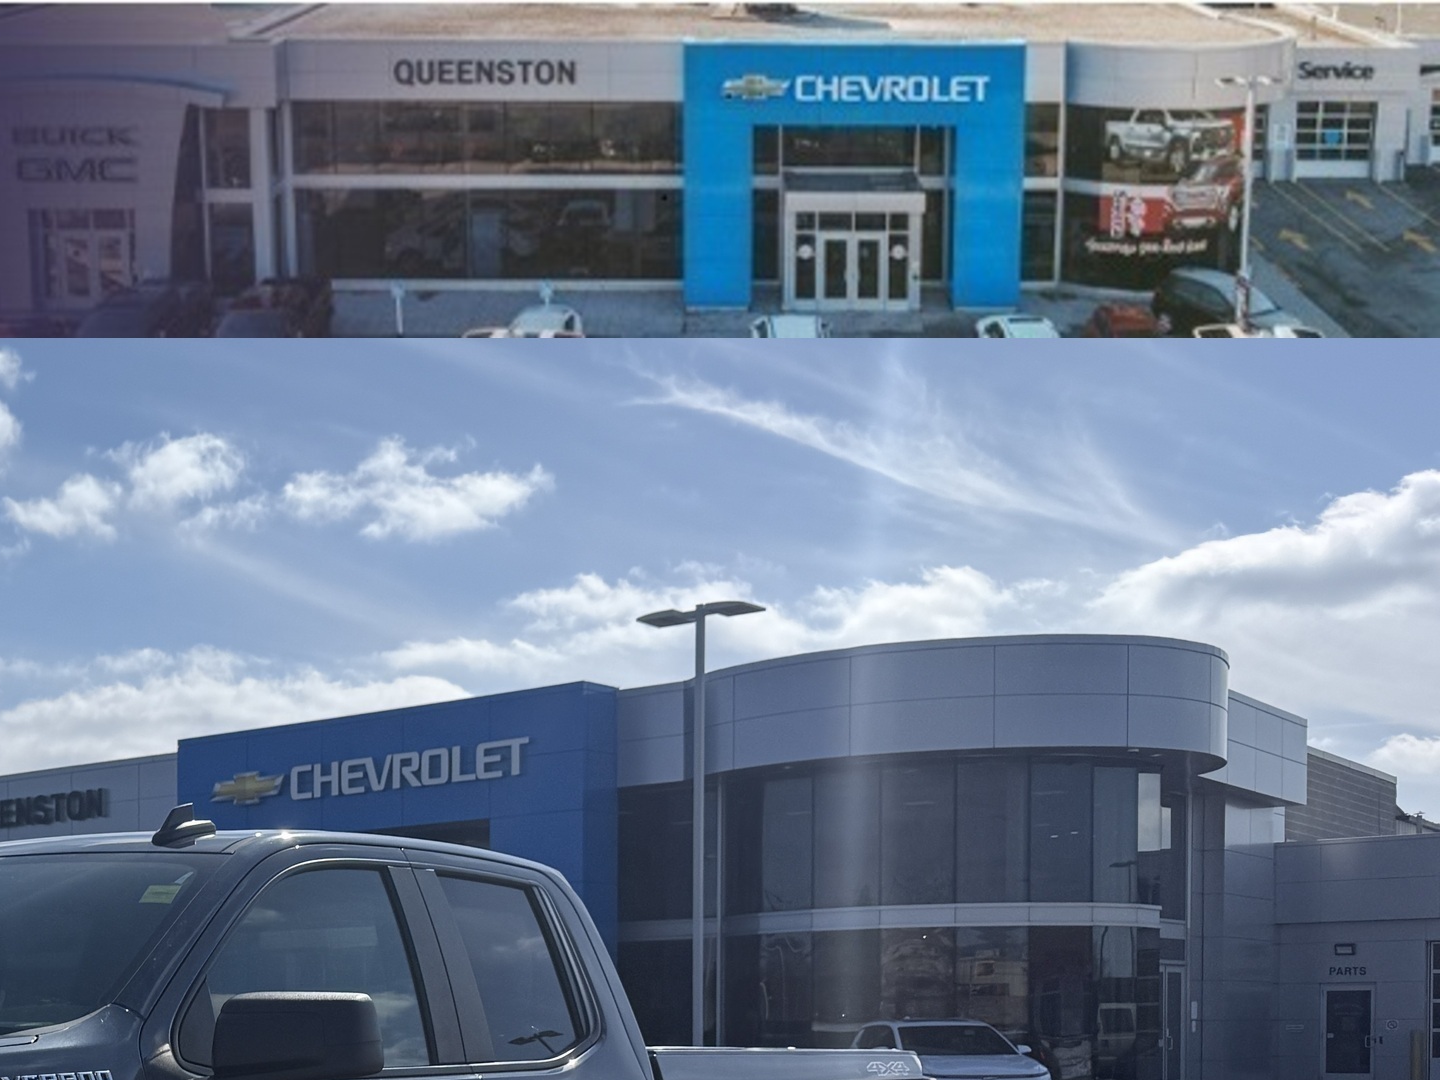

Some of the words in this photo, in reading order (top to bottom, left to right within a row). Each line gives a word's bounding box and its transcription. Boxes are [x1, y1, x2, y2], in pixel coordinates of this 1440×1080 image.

[393, 59, 577, 86] QUEENSTON
[1298, 61, 1374, 80] Service
[794, 75, 991, 102] CHEVROLET
[11, 124, 141, 147] BUICK
[17, 156, 139, 182] GMC
[290, 736, 529, 800] CHEVROLET
[1329, 966, 1367, 976] PARTS
